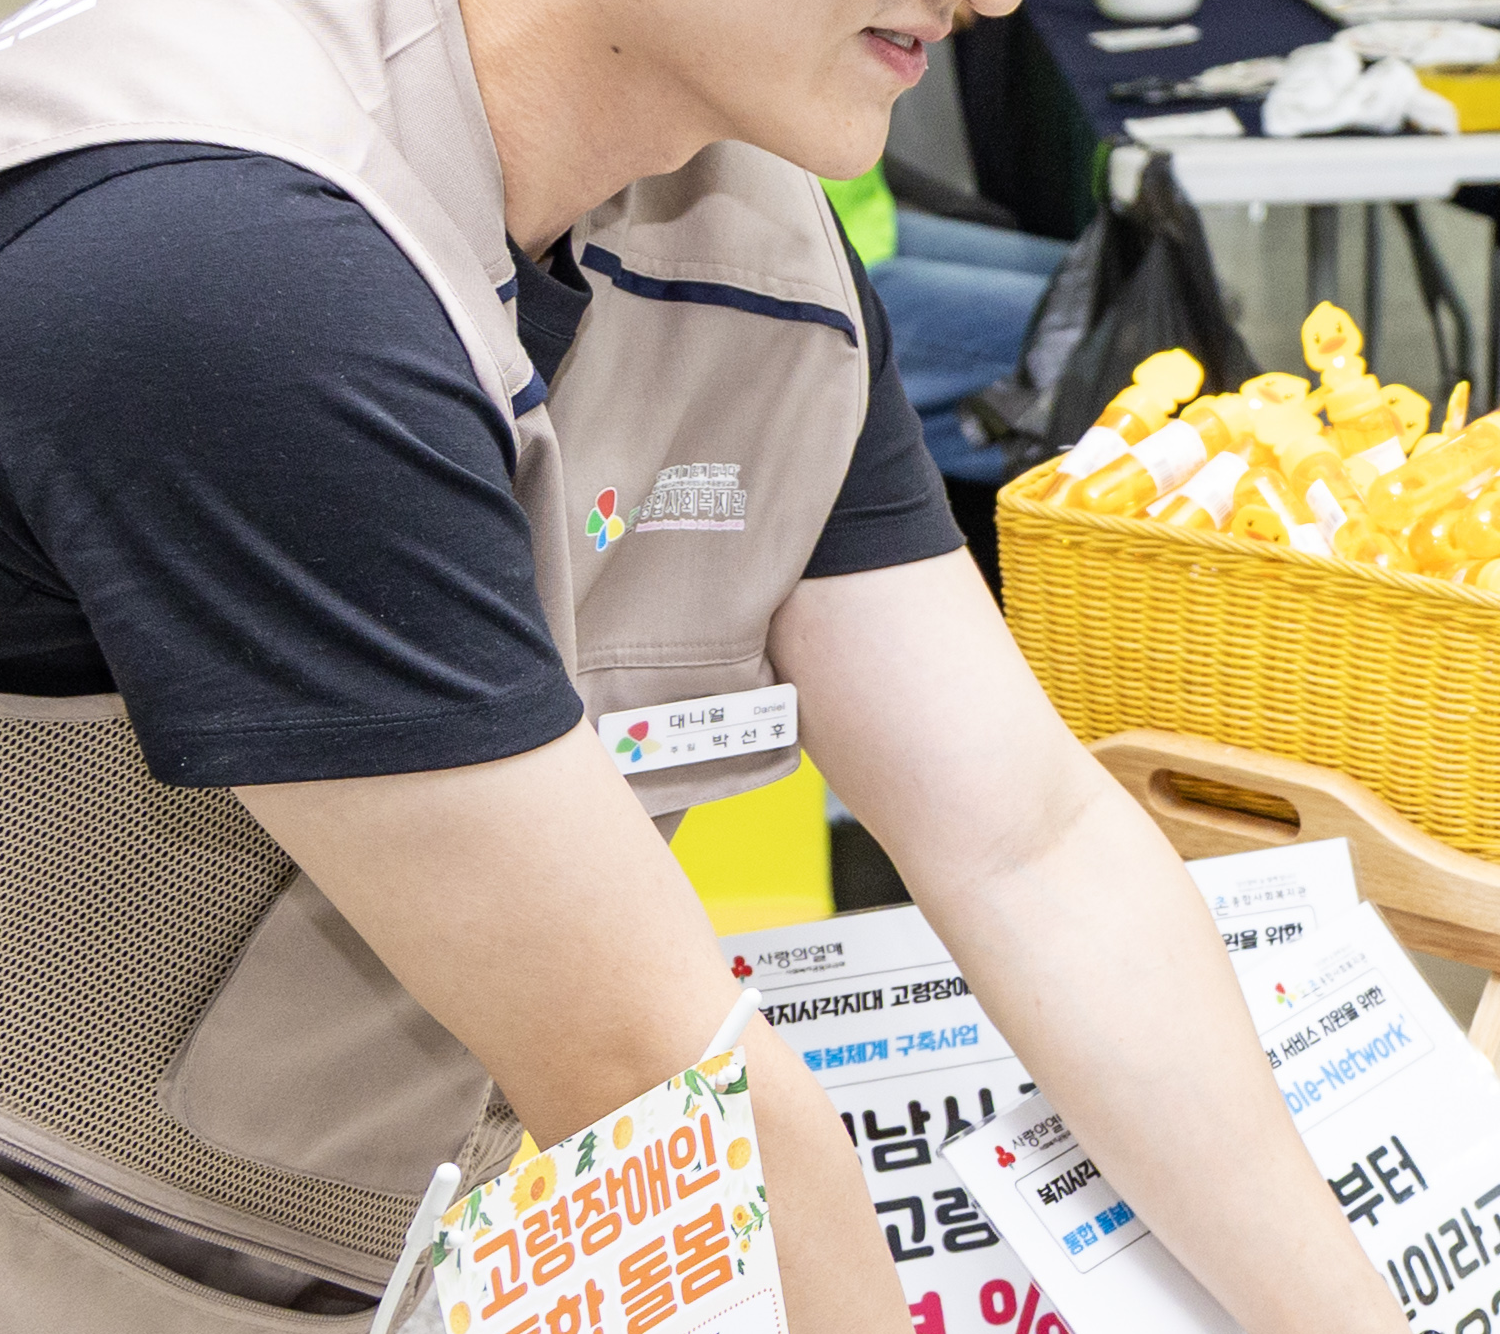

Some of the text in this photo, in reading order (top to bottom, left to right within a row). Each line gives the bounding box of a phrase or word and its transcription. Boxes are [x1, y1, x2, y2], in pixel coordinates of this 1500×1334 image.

[756, 941, 844, 969] 사랑의열매
[896, 1023, 979, 1056] 구축사업
[841, 1087, 997, 1173] 남시
[473, 1113, 722, 1320] 고령장애인
